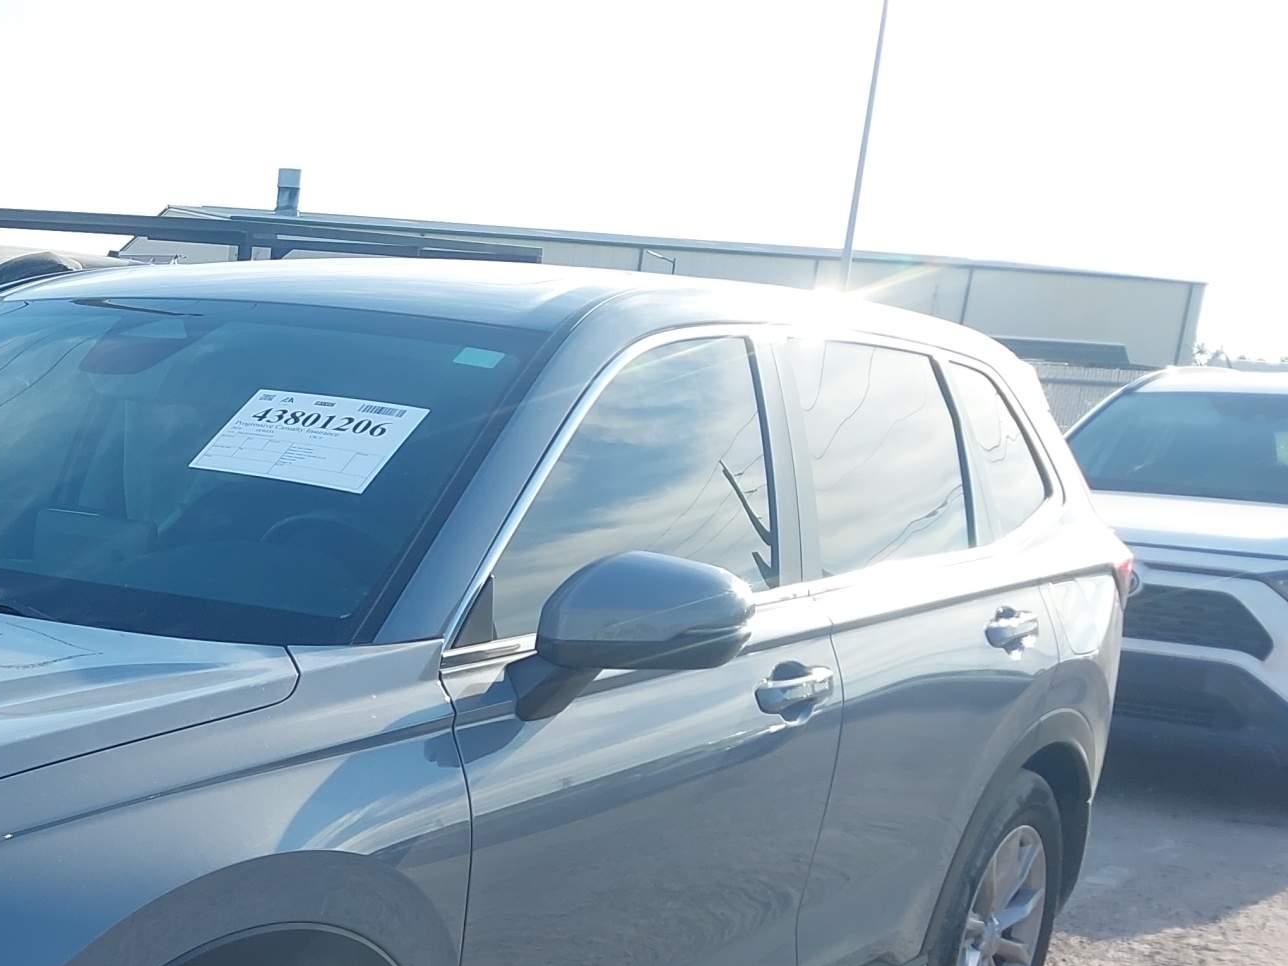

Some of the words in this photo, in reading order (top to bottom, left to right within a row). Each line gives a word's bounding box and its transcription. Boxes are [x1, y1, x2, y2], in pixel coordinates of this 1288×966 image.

[234, 419, 274, 430] Progressive
[305, 427, 340, 437] Insurance
[251, 406, 394, 438] 43801206
